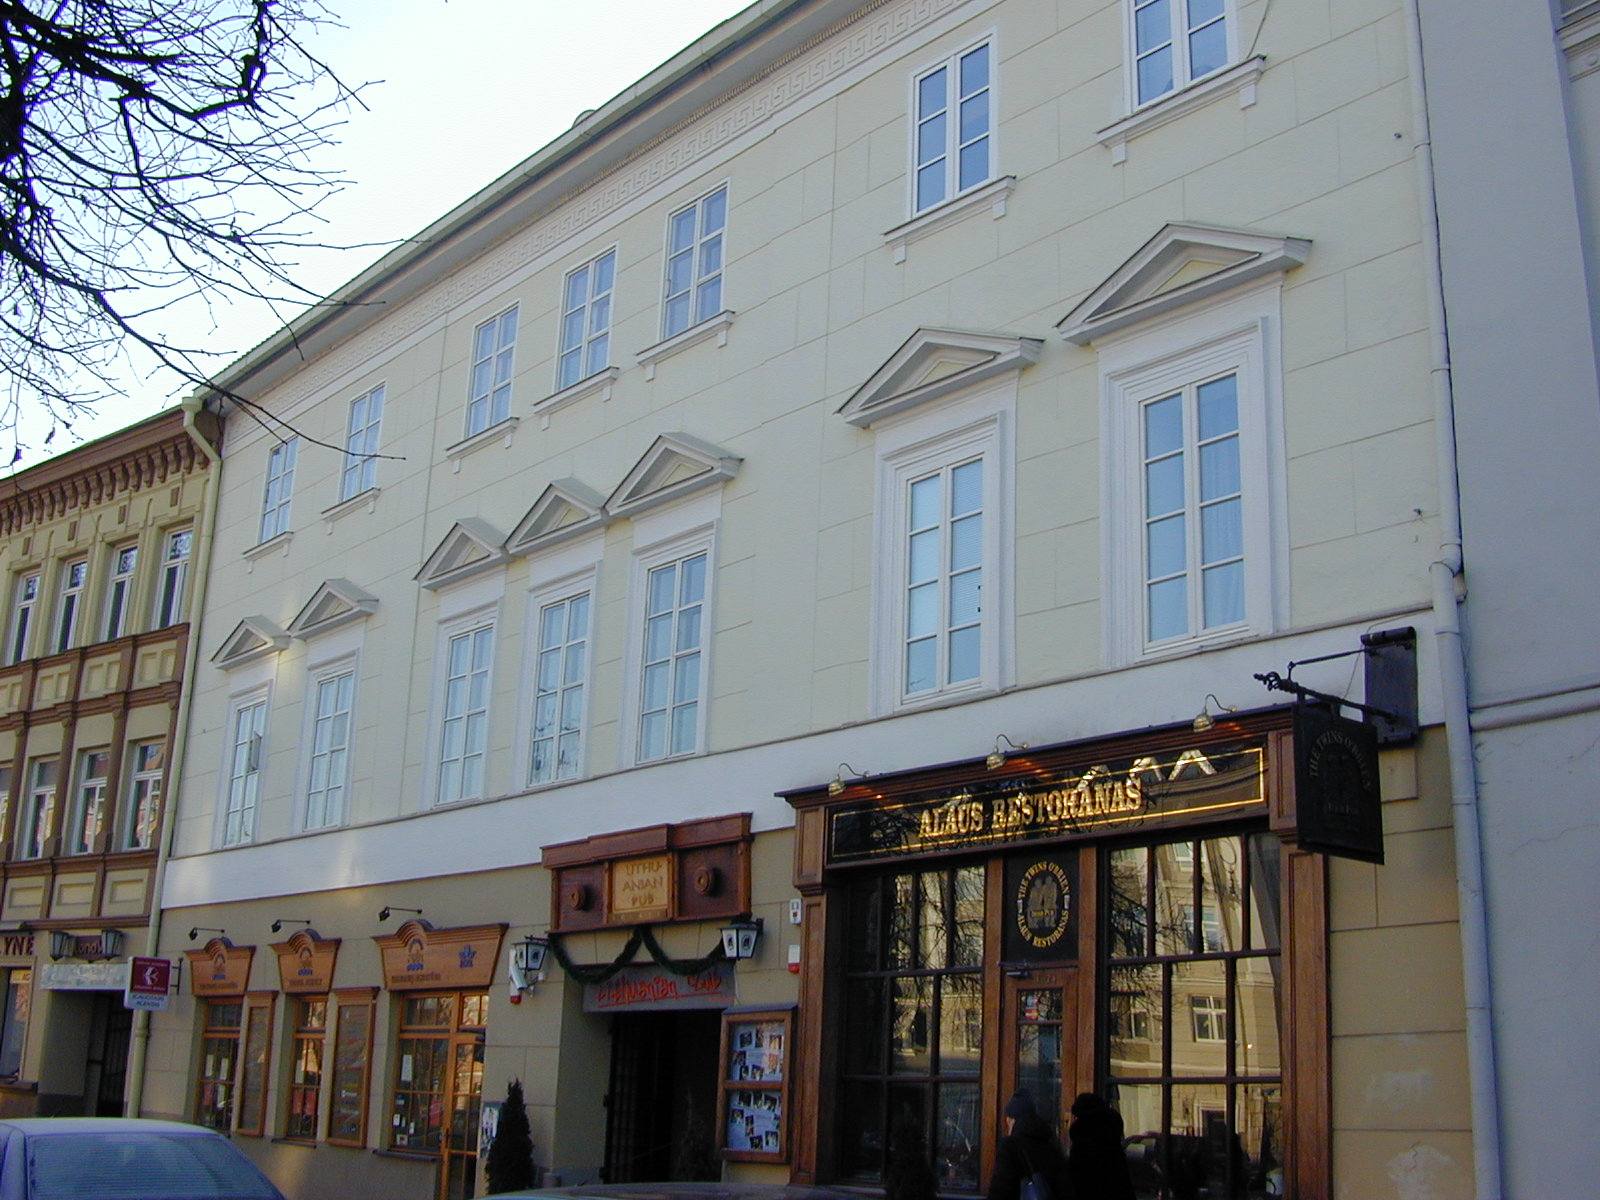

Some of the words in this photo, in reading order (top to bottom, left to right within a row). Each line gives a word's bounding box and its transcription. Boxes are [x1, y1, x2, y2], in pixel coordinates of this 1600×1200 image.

[918, 801, 984, 838] ALAUS
[991, 778, 1142, 830] RESTORANAS
[1026, 861, 1047, 879] TWINS
